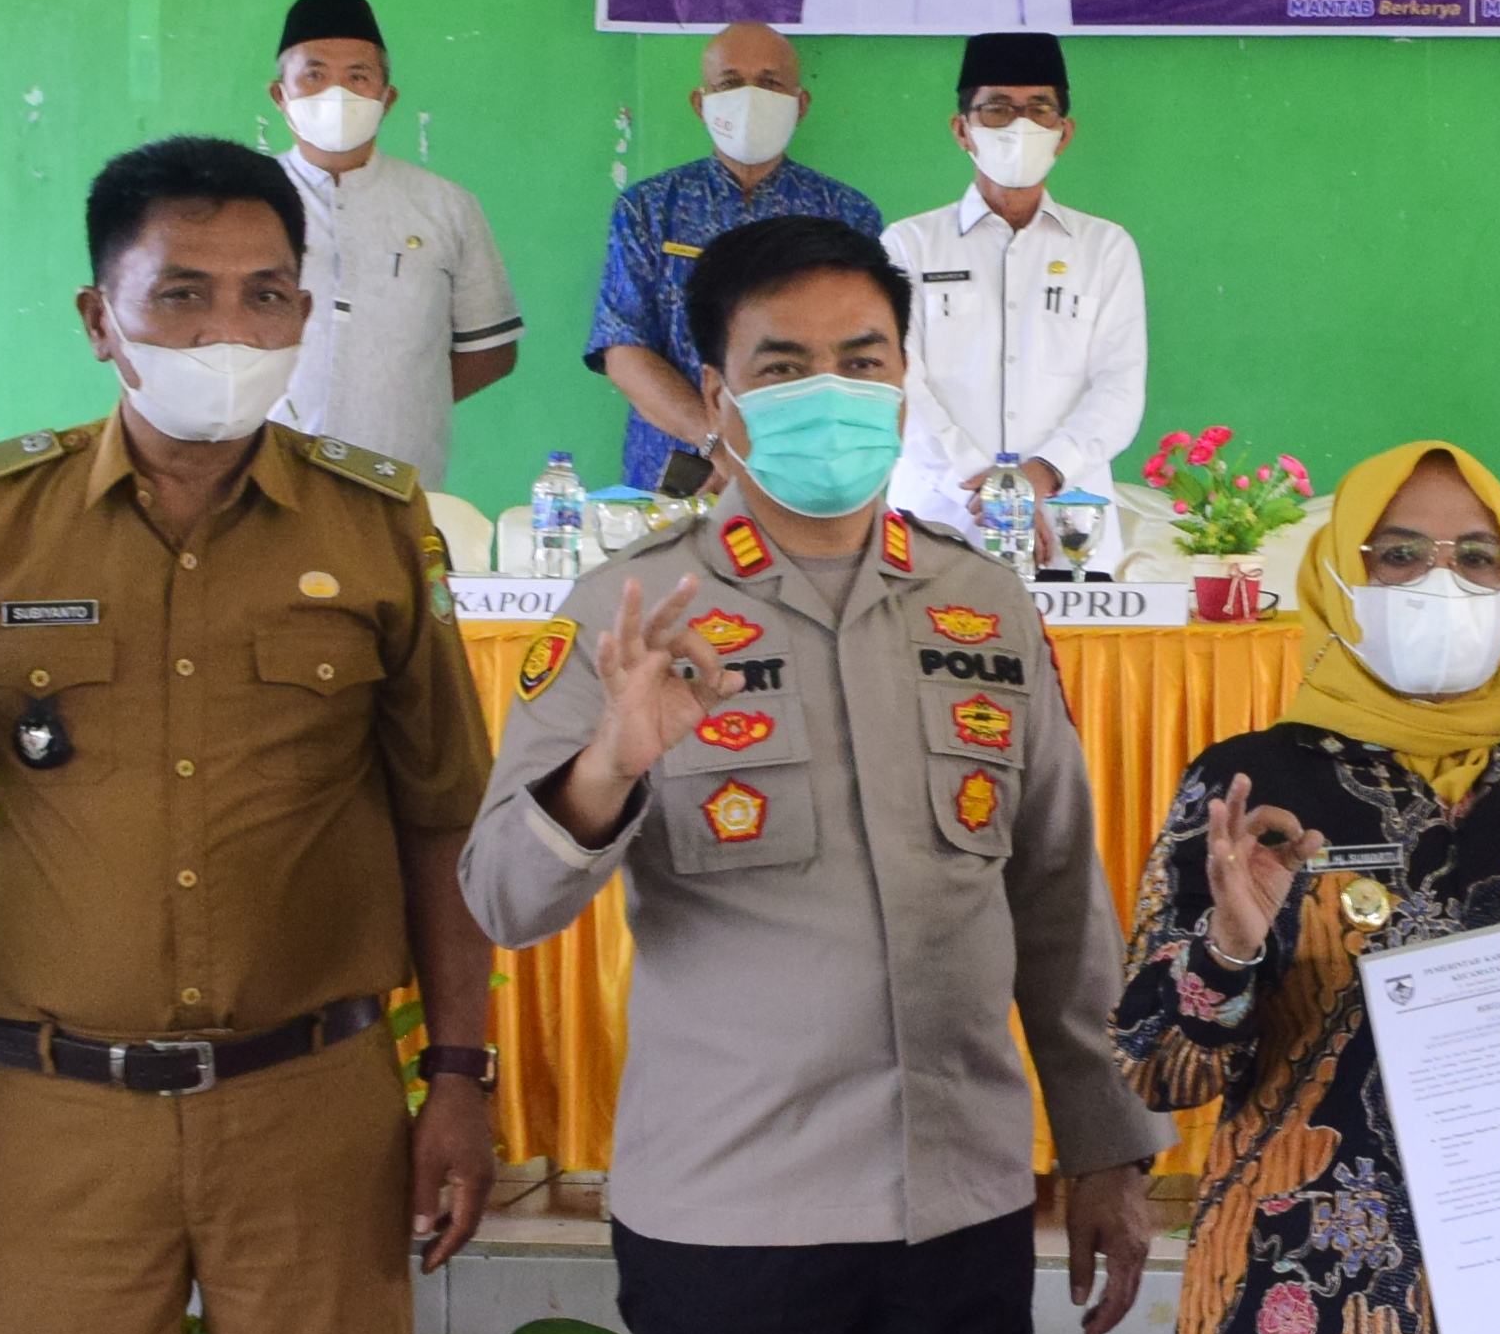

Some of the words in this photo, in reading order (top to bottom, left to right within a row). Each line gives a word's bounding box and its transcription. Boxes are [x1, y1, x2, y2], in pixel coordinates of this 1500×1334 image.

[1378, 0, 1462, 19] Berkarya
[1031, 590, 1147, 617] DPRD
[919, 649, 1025, 685] POLRI
